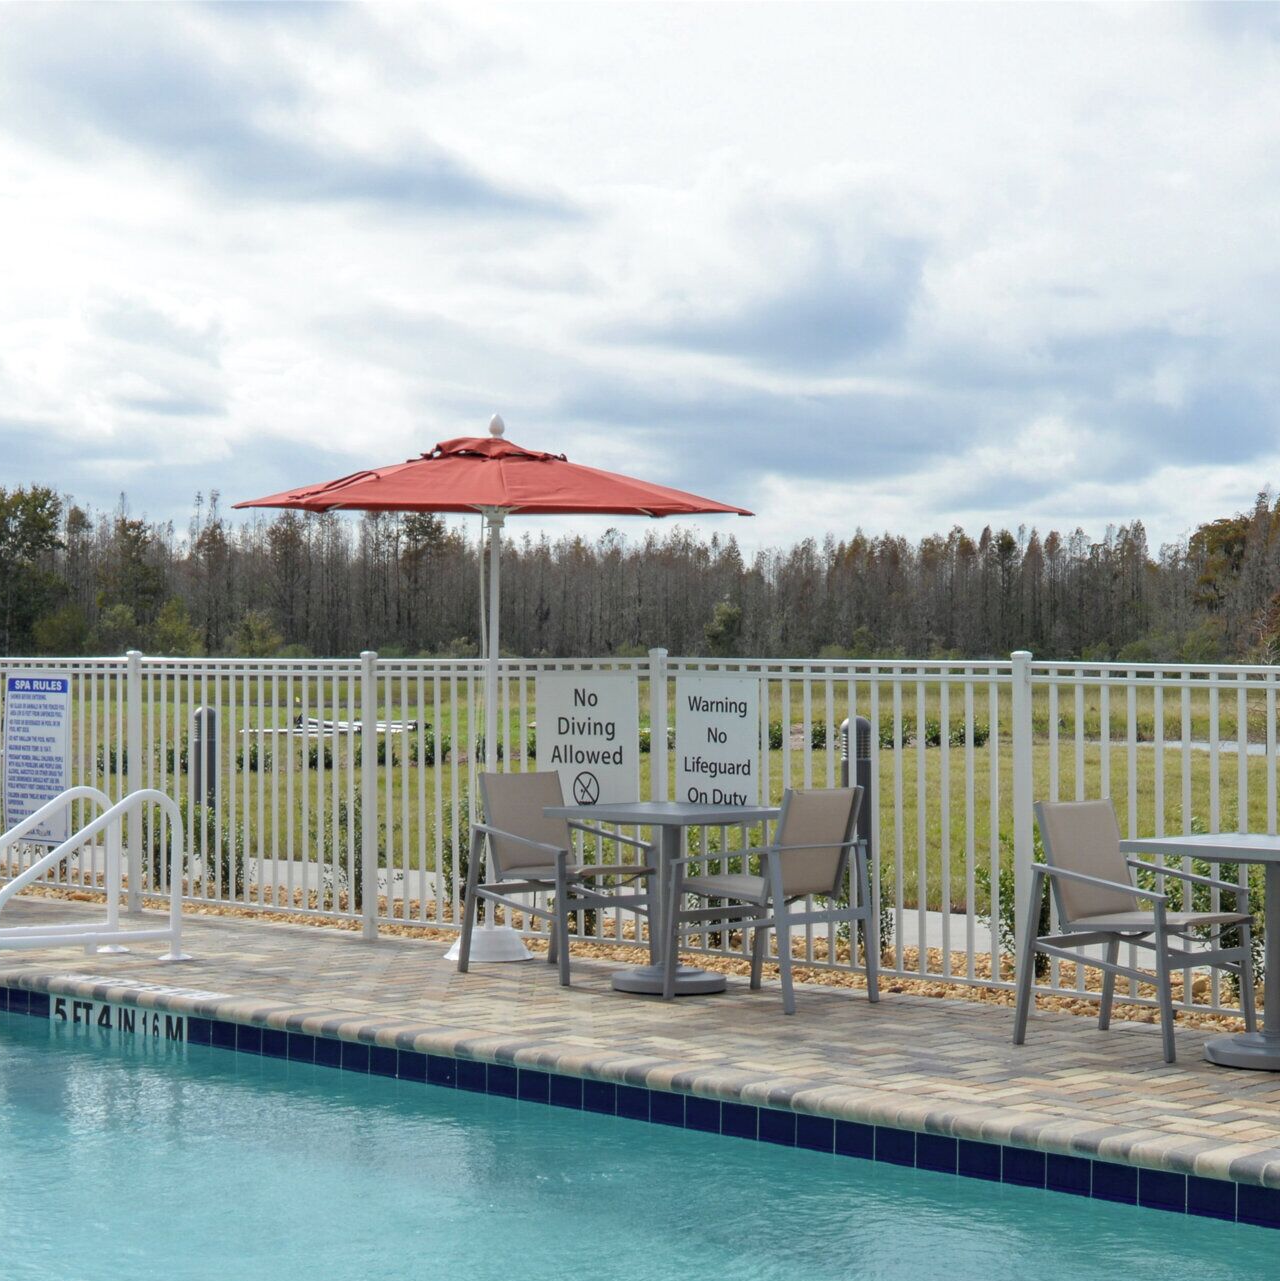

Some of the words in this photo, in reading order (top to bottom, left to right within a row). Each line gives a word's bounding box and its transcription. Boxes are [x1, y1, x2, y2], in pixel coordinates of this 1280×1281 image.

[14, 680, 32, 691] SPA
[32, 680, 63, 691] RULES
[573, 688, 598, 707] No
[687, 695, 748, 718] Warning
[557, 716, 616, 741] Diving
[706, 727, 728, 744] No
[550, 745, 623, 765] Allowed
[683, 756, 751, 778] Lifeguard
[687, 787, 708, 804] On
[712, 788, 748, 806] Duty
[54, 997, 67, 1021] 5
[72, 1000, 94, 1026] FT
[97, 1004, 113, 1029] 4
[118, 1006, 136, 1034] IN
[165, 1014, 184, 1042] M
